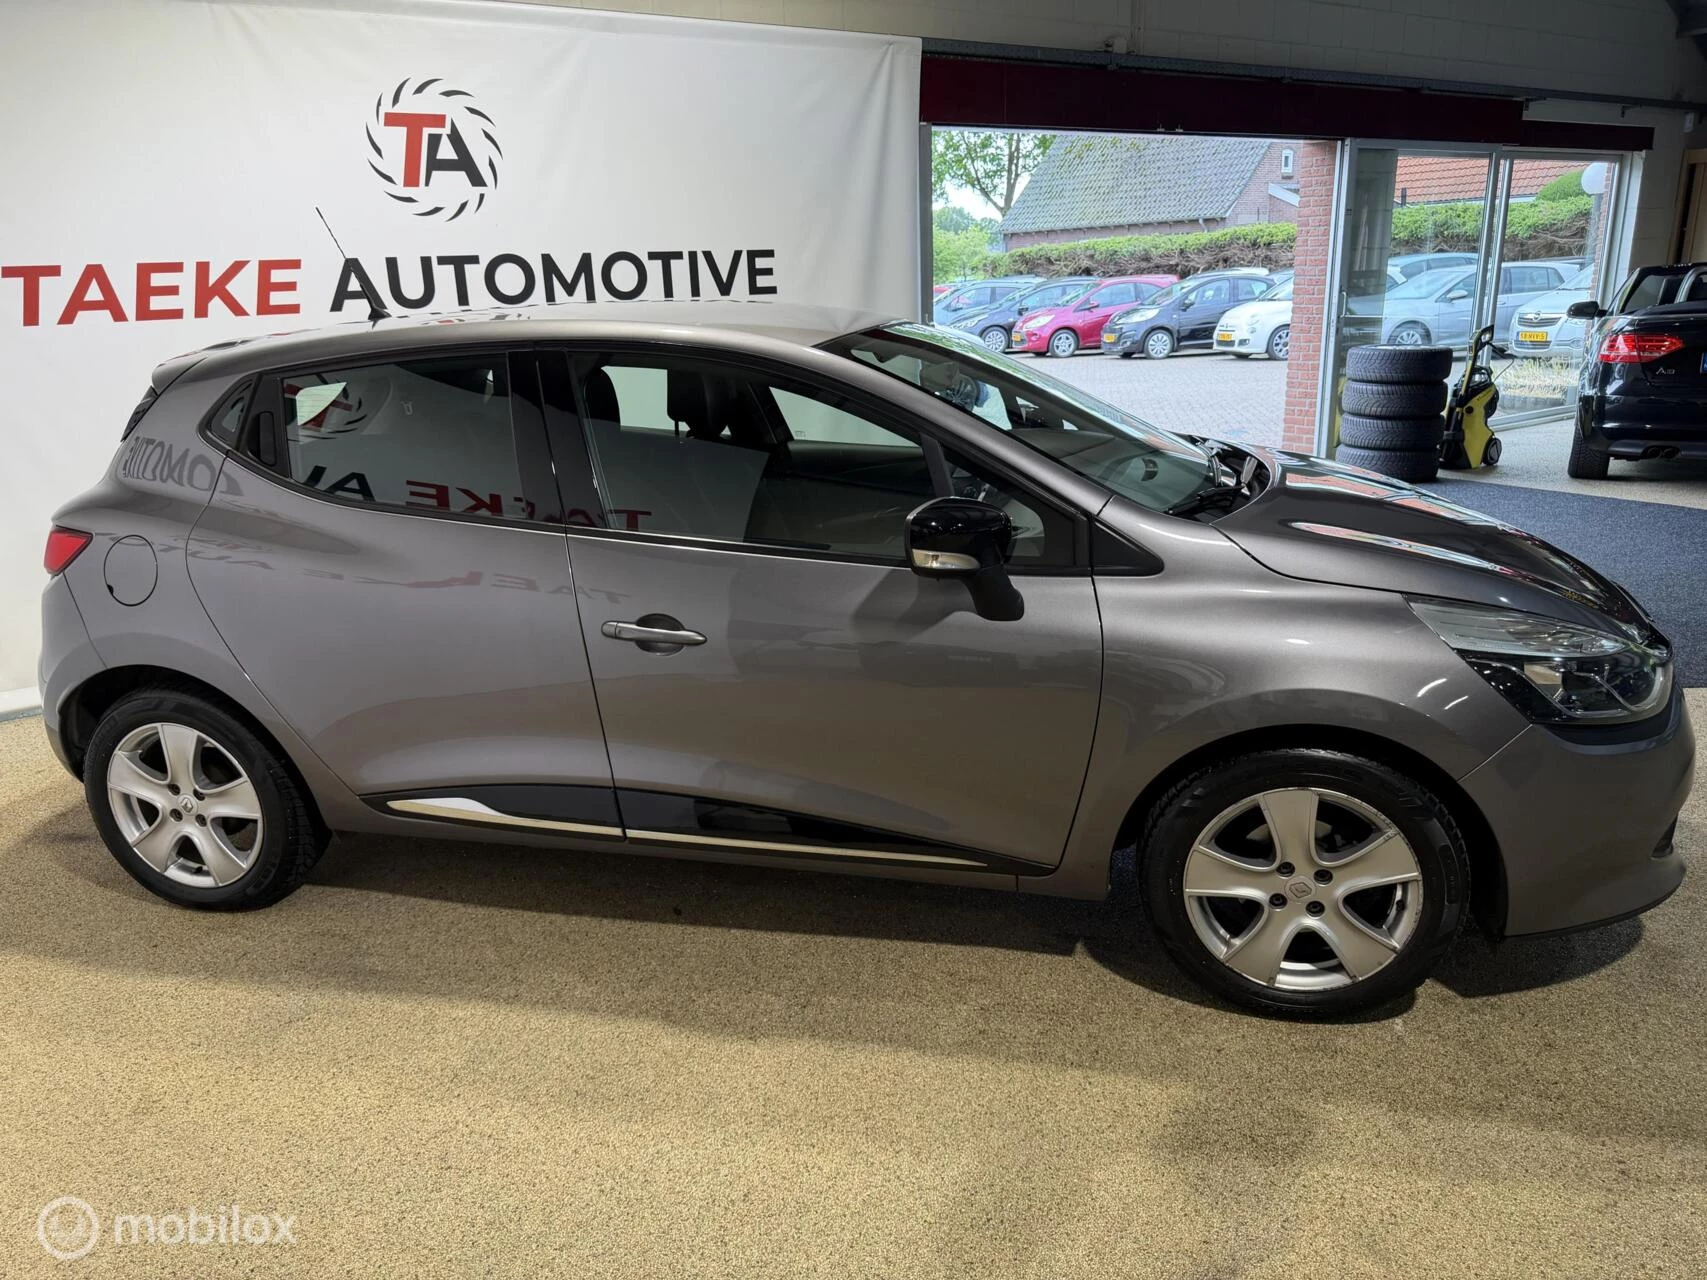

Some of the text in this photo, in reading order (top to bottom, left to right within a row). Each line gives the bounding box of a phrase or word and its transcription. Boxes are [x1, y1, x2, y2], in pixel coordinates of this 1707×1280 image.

[384, 111, 487, 188] TA
[2, 249, 777, 327] TAEKE AUTOMOTIVE
